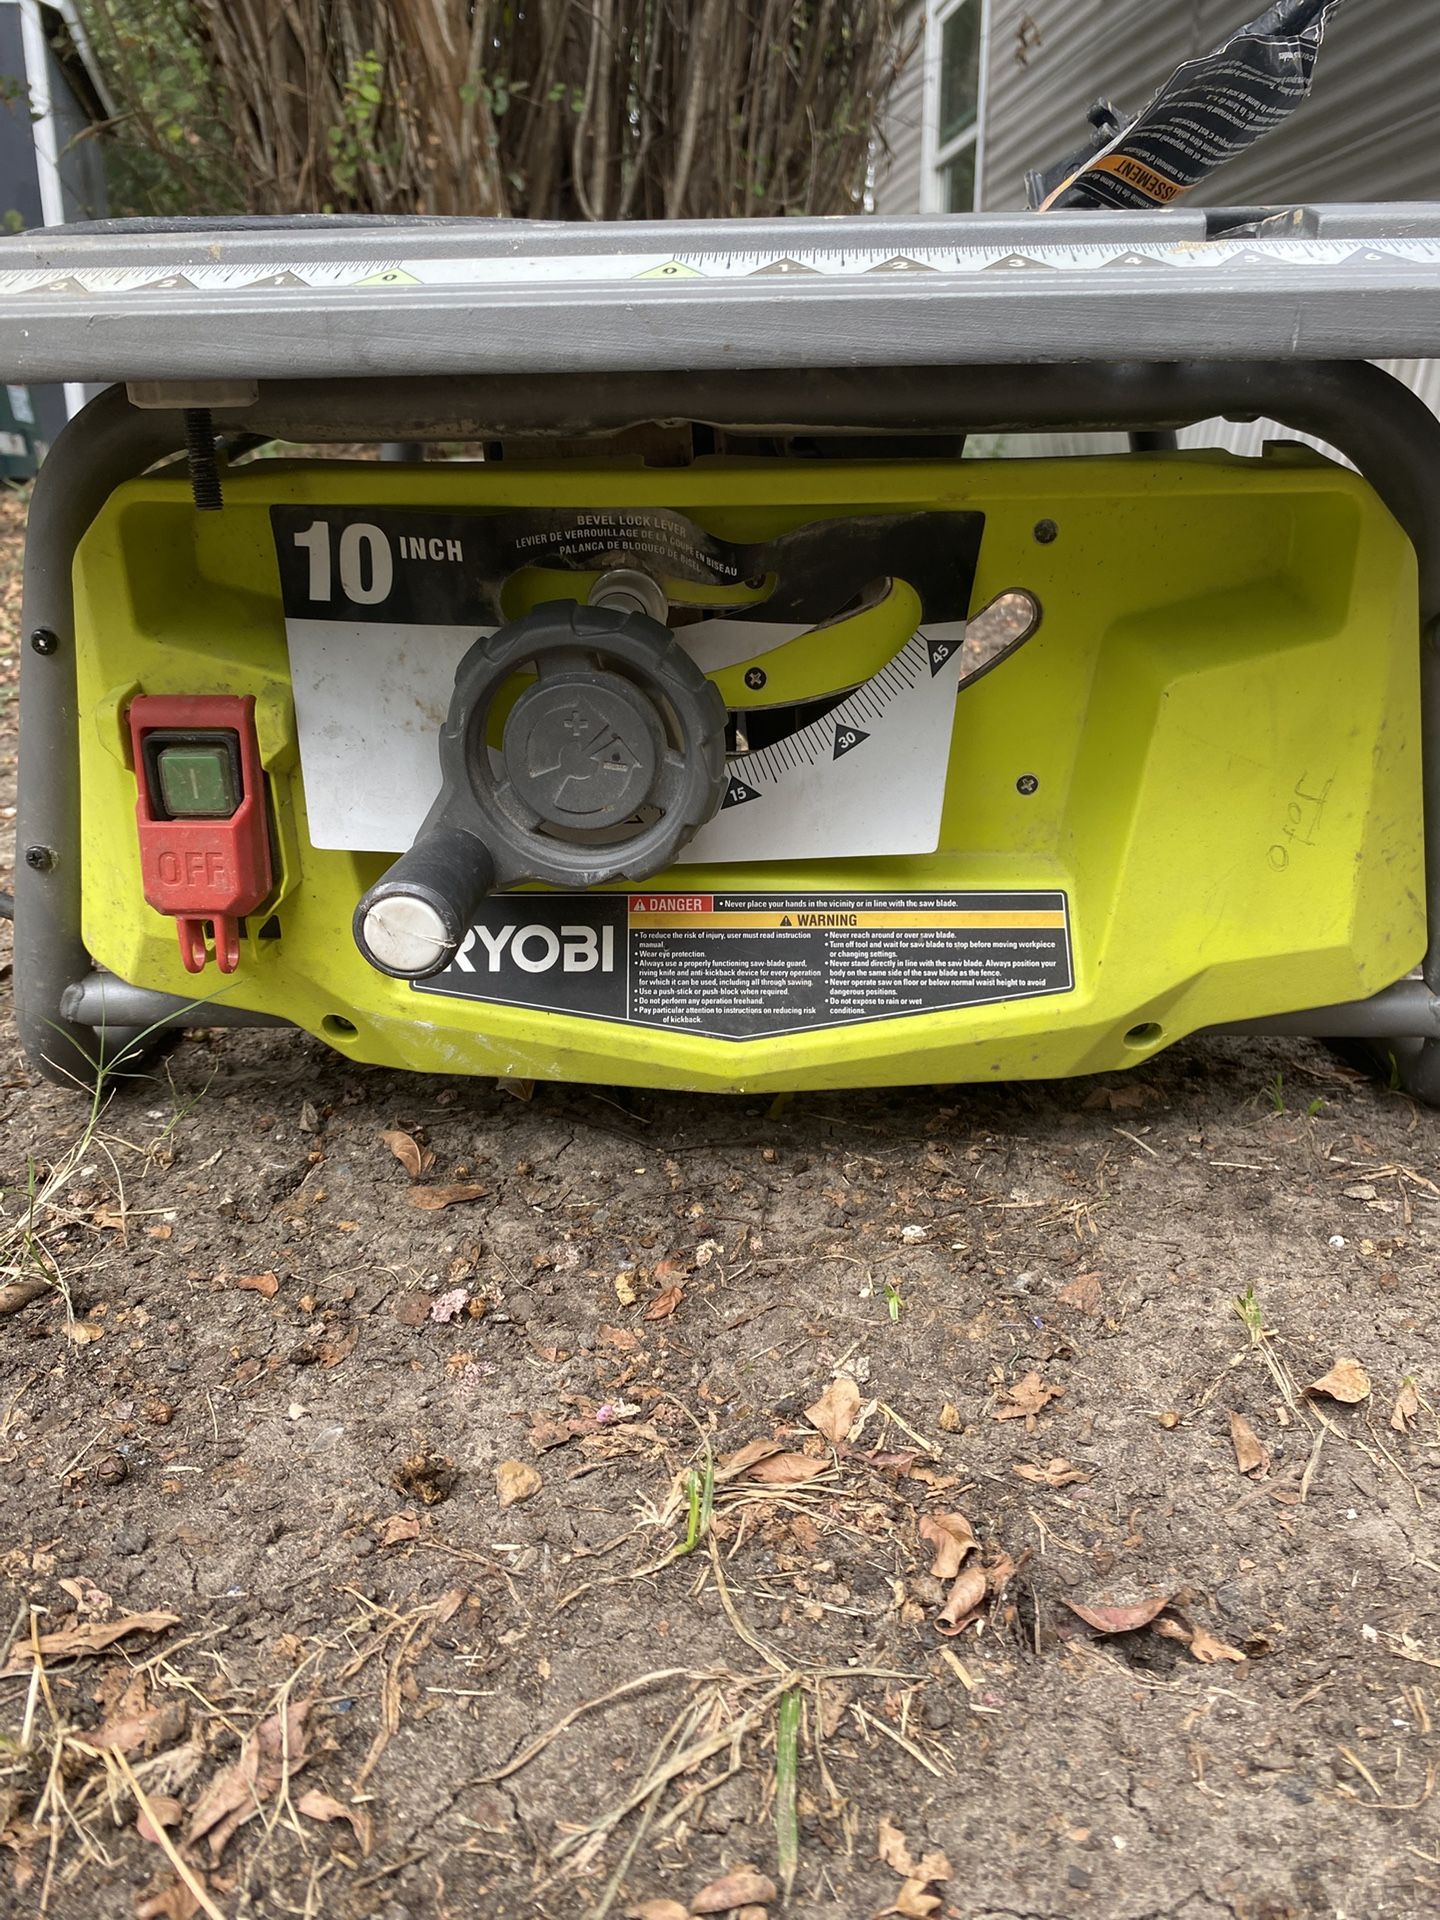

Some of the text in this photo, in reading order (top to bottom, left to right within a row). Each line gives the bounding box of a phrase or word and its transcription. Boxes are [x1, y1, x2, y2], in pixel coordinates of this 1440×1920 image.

[1114, 159, 1178, 202] ISSEMENT
[892, 262, 909, 270] 2
[1008, 258, 1026, 268] 3
[1124, 256, 1142, 265] 4
[1243, 254, 1260, 263] 5
[1364, 252, 1381, 261] 6
[577, 514, 687, 537] BEVEL LOCK LEVER
[515, 528, 738, 577] LEVIER DE VERROUILLAGE DE LA COUPE EN BISEAU
[559, 540, 704, 573] PALANCA DE BLOQUEO DE BISEL
[294, 520, 464, 605] 10 INCH
[932, 644, 949, 664] 45
[838, 732, 856, 749] 30
[729, 787, 747, 802] 15
[158, 851, 225, 887] OFF
[650, 898, 702, 911] DANGER
[724, 900, 958, 908] Never place your hands in the vicinity or in line with the saw blade.
[797, 914, 857, 927] WARNING
[829, 969, 1002, 977] body on the same side of the saw blade as the fence.
[829, 979, 1046, 987] Never operate saw on floor or below normal waist height to avoid
[829, 988, 898, 996] dangerous positions.
